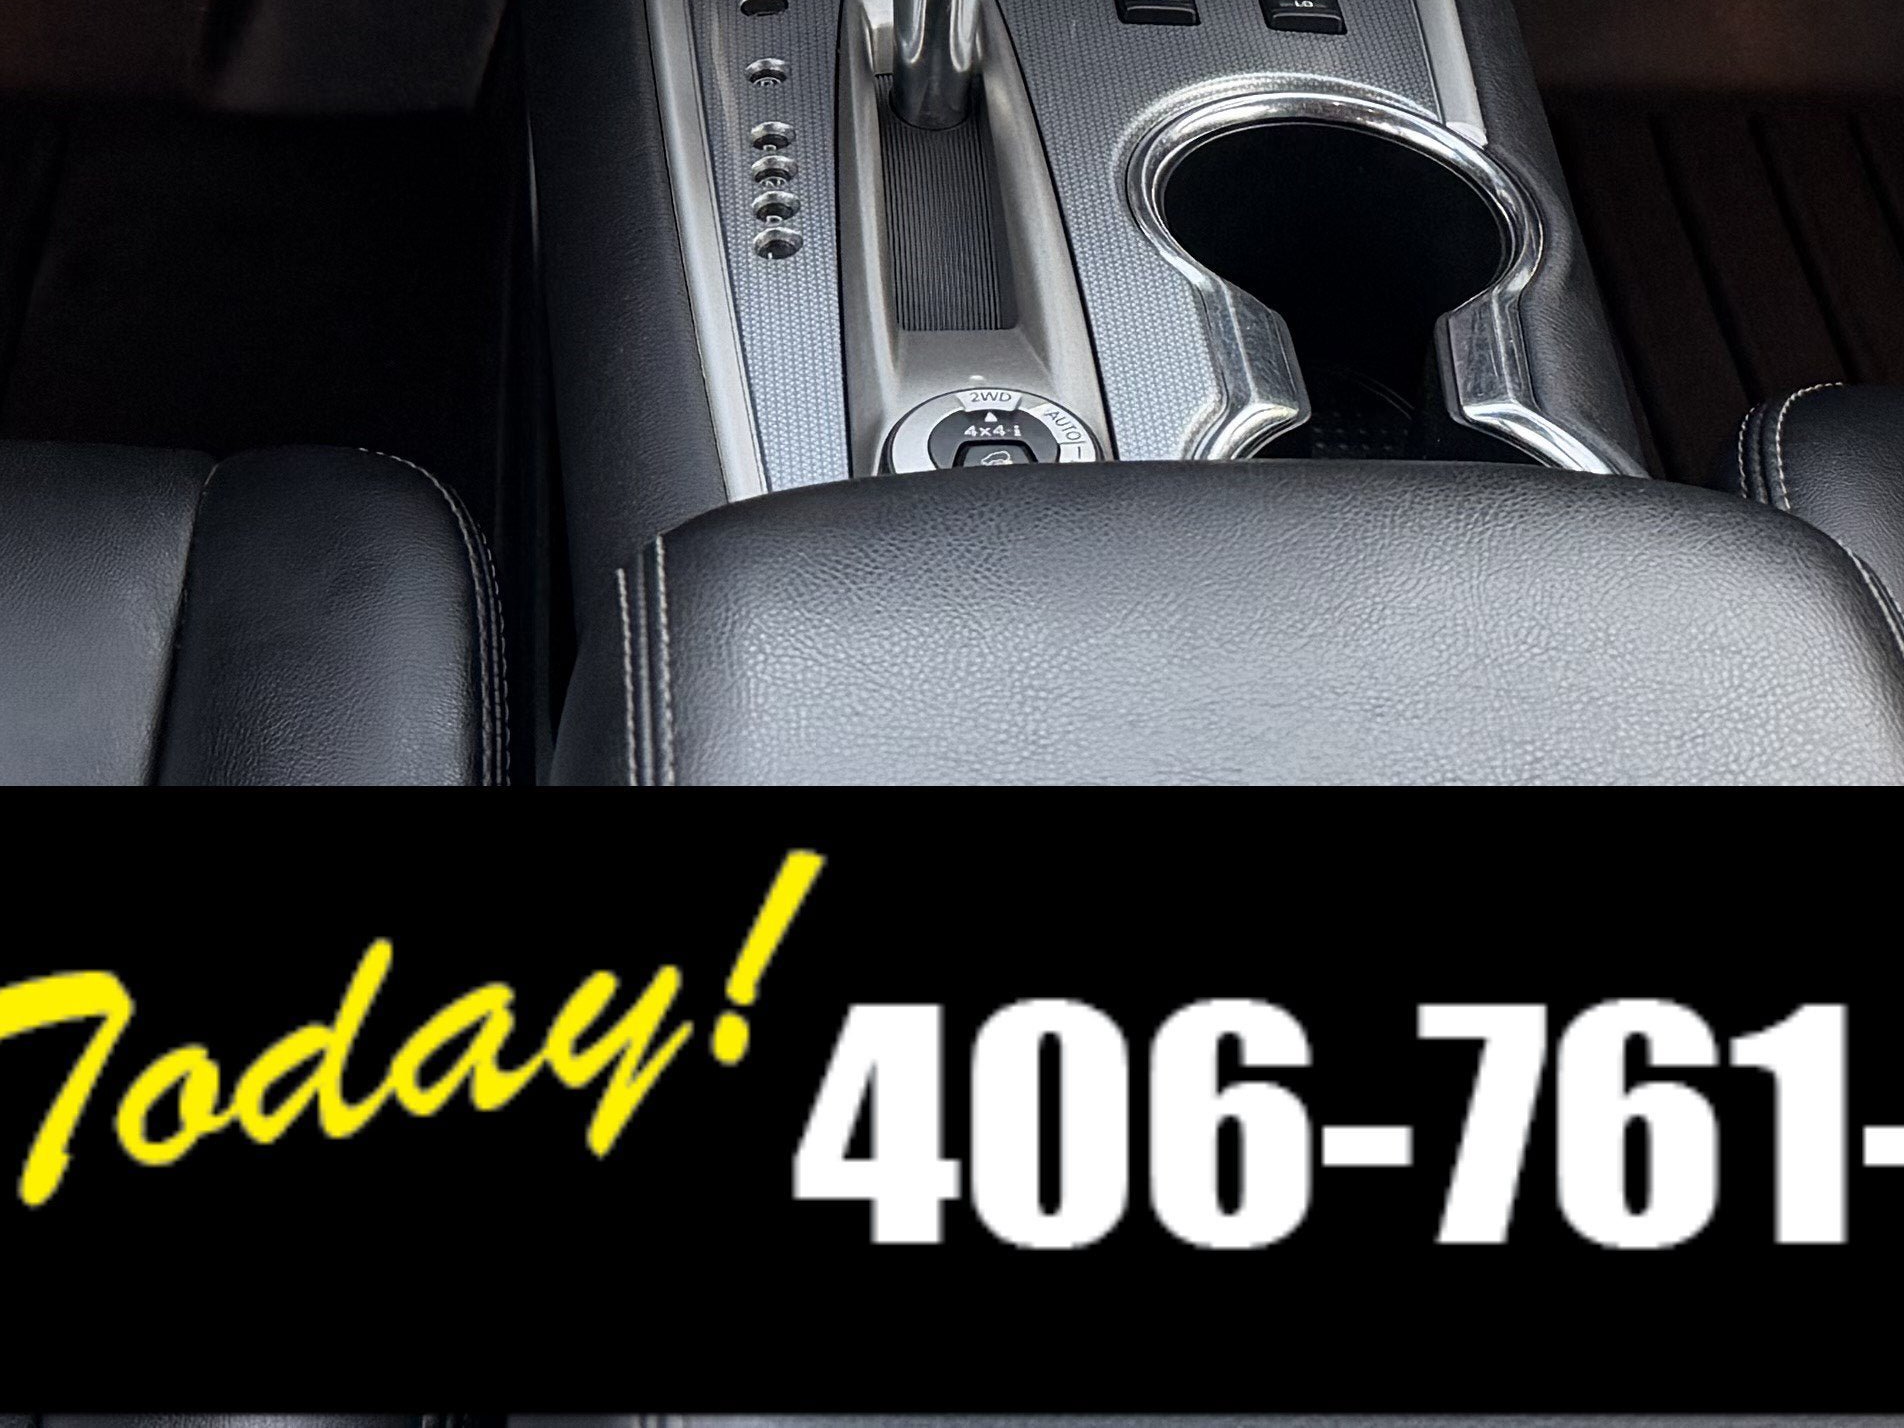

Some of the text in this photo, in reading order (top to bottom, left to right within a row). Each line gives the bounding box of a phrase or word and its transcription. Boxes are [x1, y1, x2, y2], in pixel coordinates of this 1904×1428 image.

[1295, 0, 1314, 8] LO
[970, 391, 1012, 403] 2WD
[1046, 410, 1083, 441] AUTO
